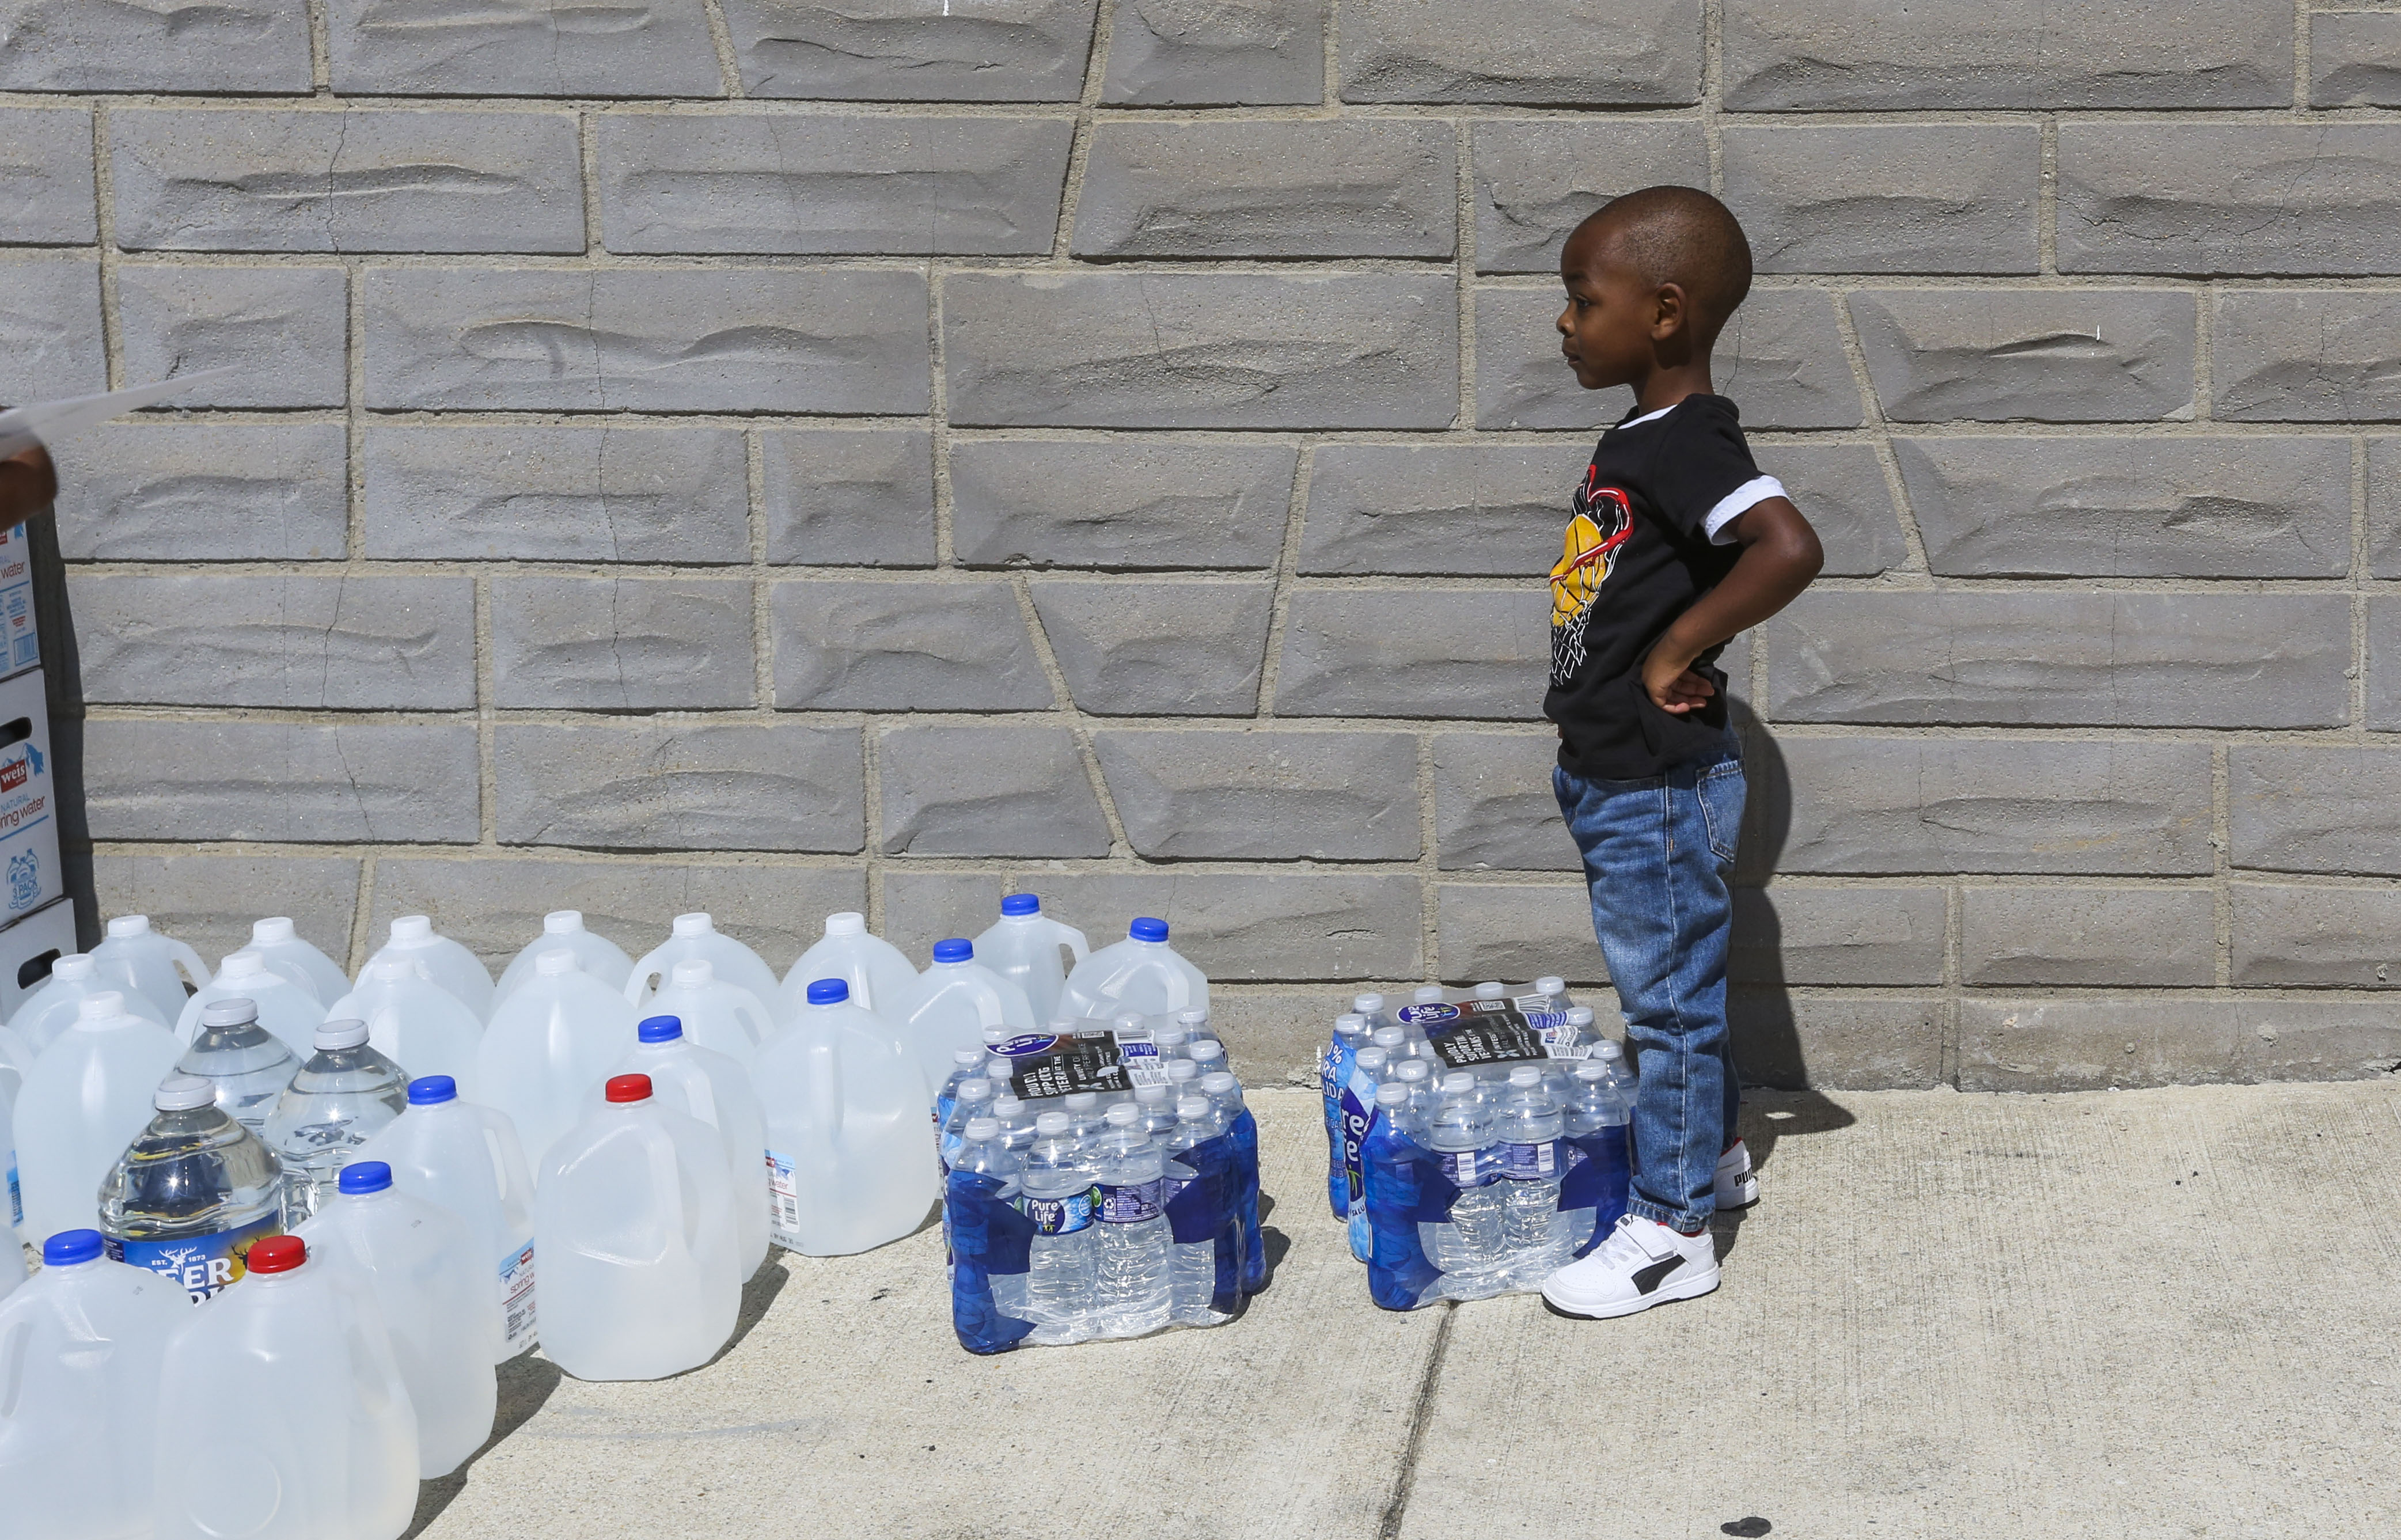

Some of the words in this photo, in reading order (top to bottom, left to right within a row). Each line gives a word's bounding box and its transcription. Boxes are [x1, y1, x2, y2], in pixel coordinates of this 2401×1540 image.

[1, 562, 25, 579] water
[1, 764, 25, 784] weis
[1, 793, 31, 812] NATURAL
[0, 810, 19, 830] ring
[20, 796, 45, 818] water
[18, 876, 38, 896] PACK
[1031, 1200, 1058, 1211] Pure
[1035, 1211, 1055, 1224] Life
[188, 1254, 206, 1262] 1873
[510, 1275, 529, 1294] spring
